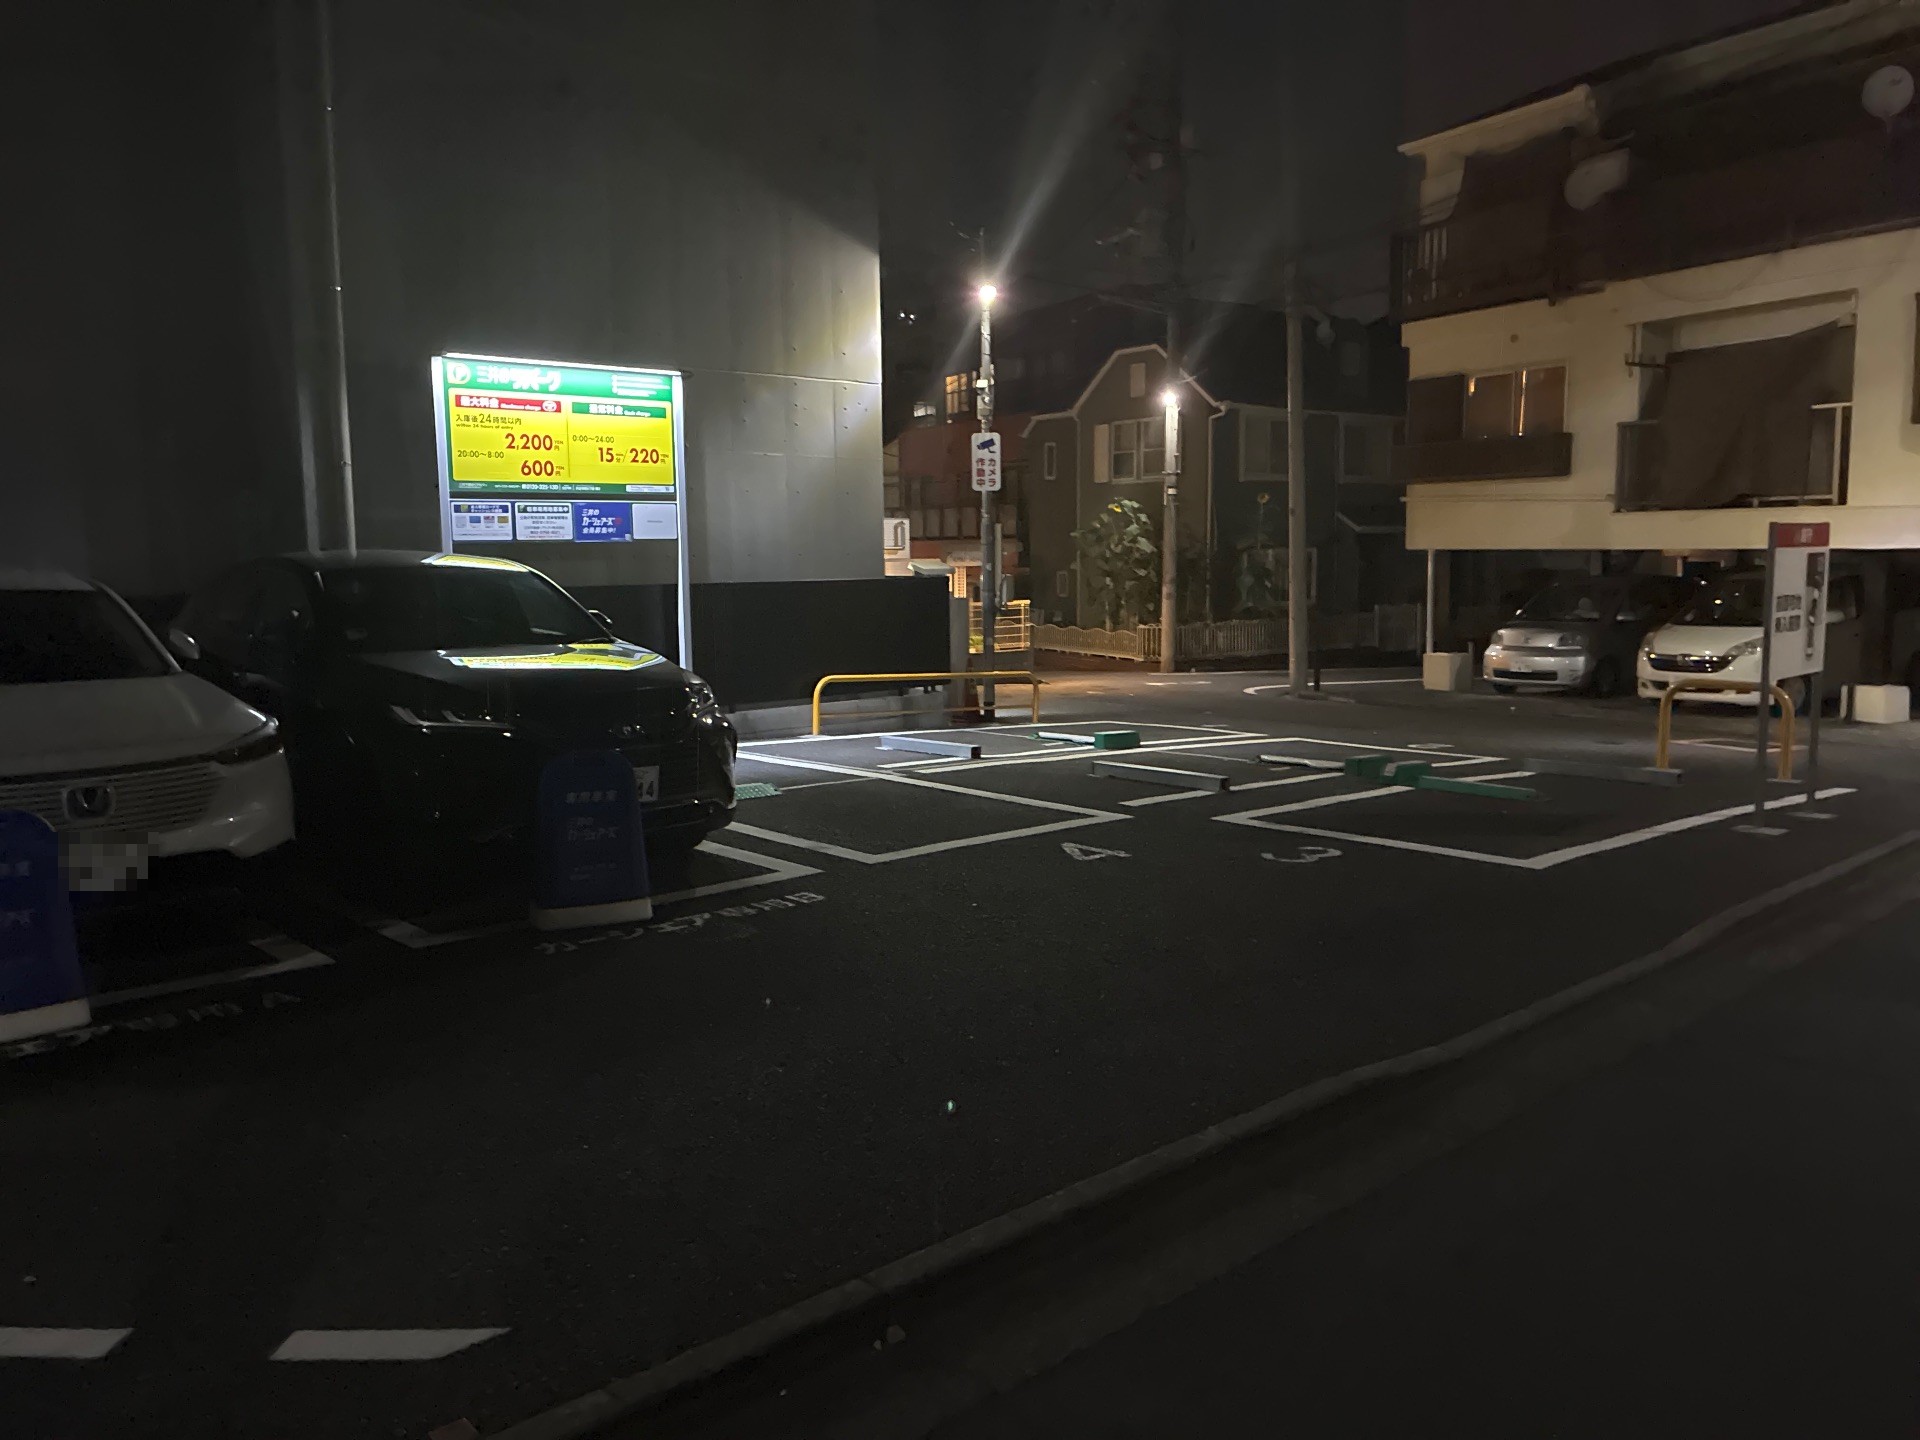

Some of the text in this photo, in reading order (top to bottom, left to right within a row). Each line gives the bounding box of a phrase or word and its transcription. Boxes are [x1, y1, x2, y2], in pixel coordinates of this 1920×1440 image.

[505, 433, 553, 451] 2,200
[629, 448, 659, 465] 220
[521, 460, 554, 476] 600
[987, 457, 997, 488] カメラ
[1062, 841, 1131, 861] 4
[1261, 846, 1343, 863] 3
